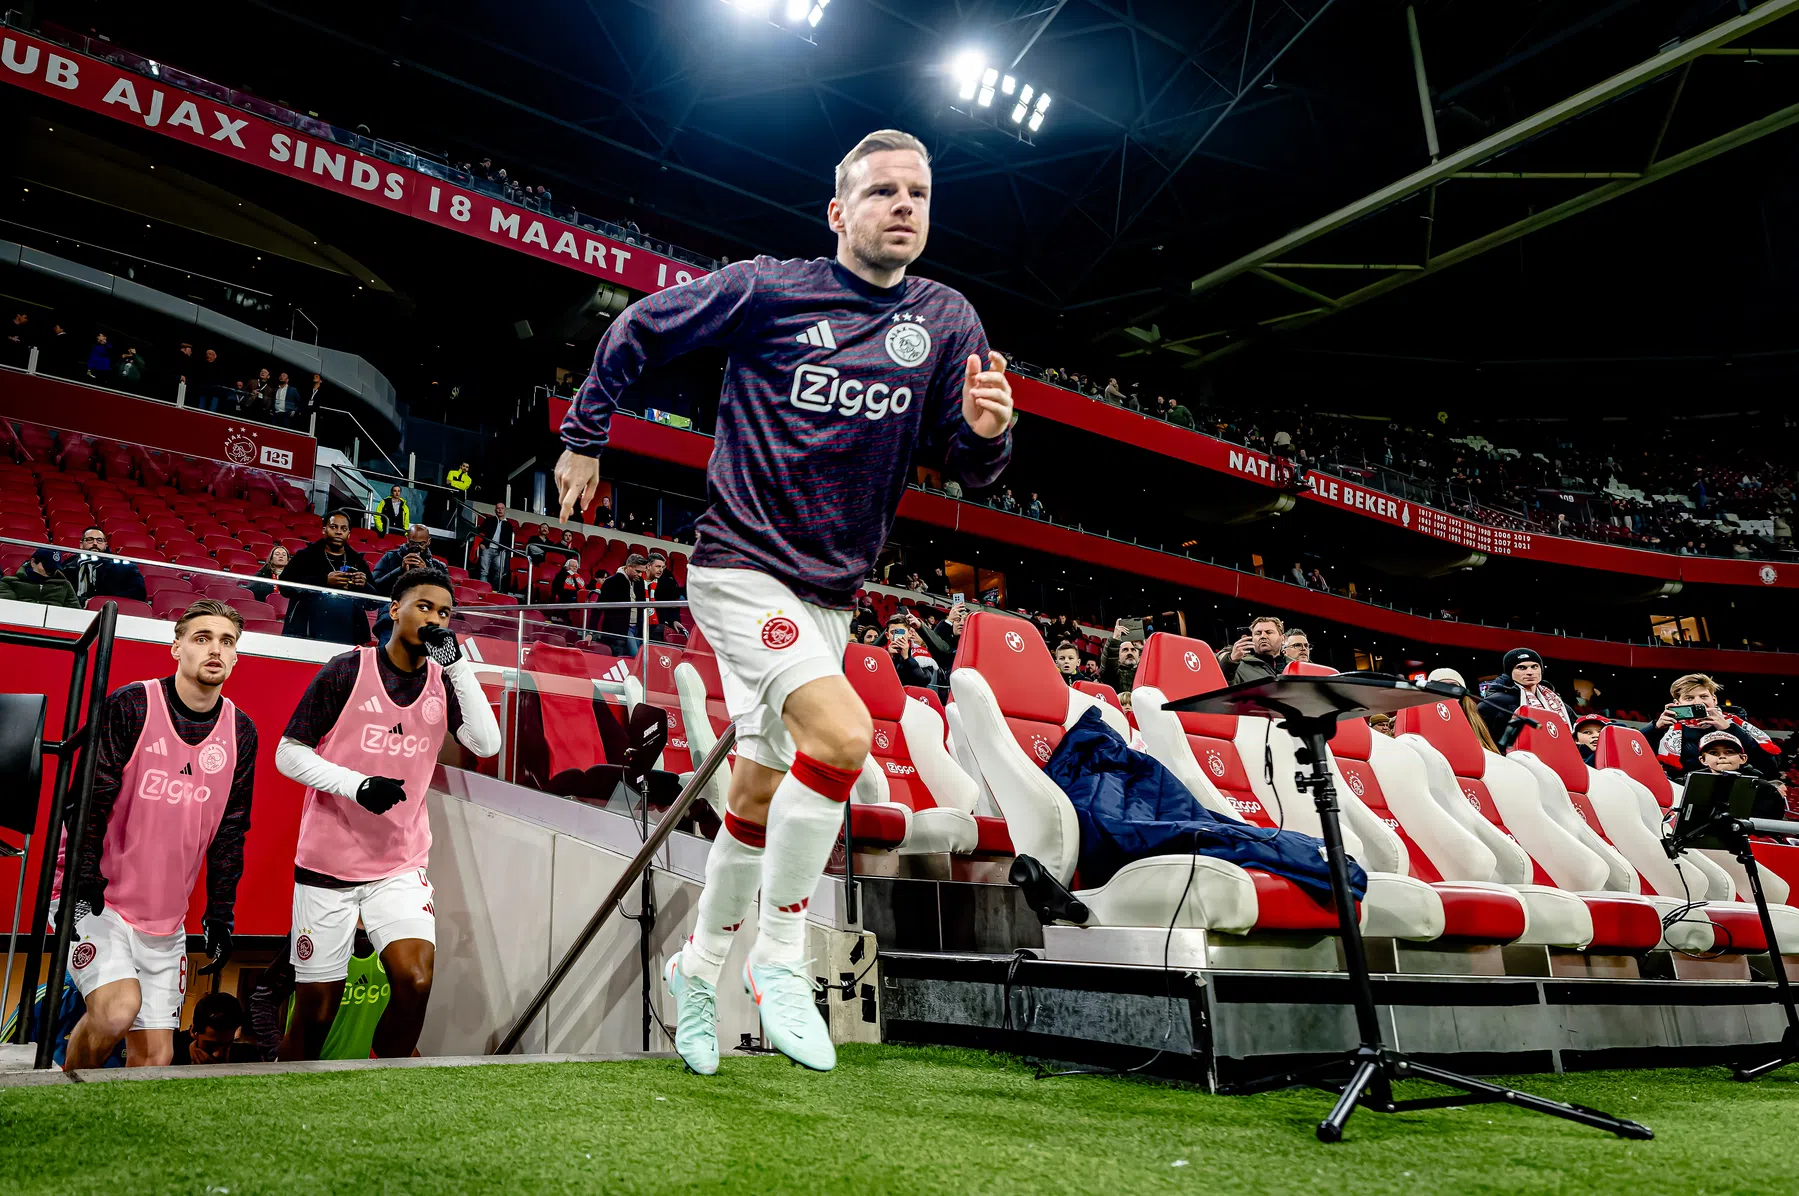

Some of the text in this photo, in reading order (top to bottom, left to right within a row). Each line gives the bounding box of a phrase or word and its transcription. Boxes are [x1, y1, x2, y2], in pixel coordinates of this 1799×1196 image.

[0, 37, 80, 91] UB
[102, 78, 249, 151] AJAX
[269, 133, 405, 201] SINDS
[428, 186, 472, 223] 18
[488, 207, 631, 276] MAART
[889, 325, 908, 341] AJAX
[790, 363, 913, 421] Ziggo
[224, 433, 241, 447] AJAX
[265, 450, 289, 466] 125
[1343, 486, 1398, 520] BEKER
[1418, 508, 1432, 518] 1917
[1494, 531, 1511, 540] 2006
[1513, 533, 1531, 542] 2019
[1494, 538, 1511, 547] 2007
[1513, 541, 1531, 550] 2021
[1494, 546, 1511, 554] 2010
[360, 723, 430, 758] Ziggo
[886, 761, 915, 774] Ziggo
[138, 768, 211, 804] Ziggo
[1226, 796, 1261, 813] Ziggo
